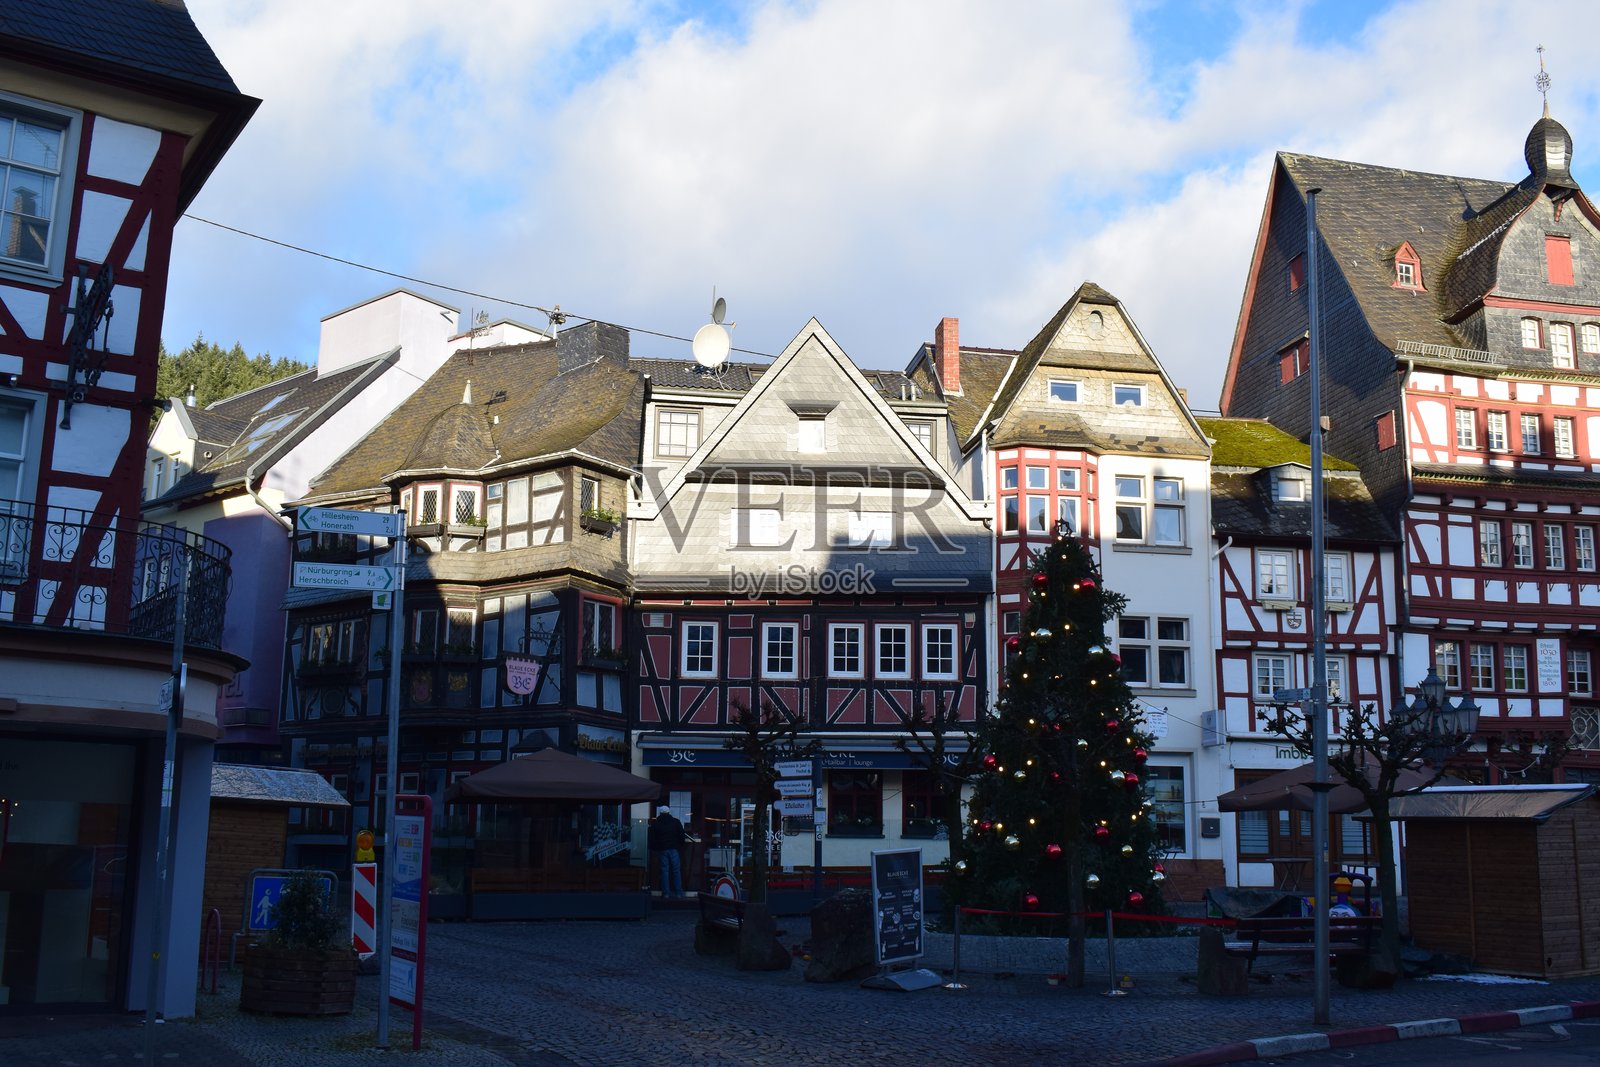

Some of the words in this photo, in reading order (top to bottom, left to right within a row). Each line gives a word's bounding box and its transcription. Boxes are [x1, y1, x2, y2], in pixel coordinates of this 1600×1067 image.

[321, 511, 359, 521] Hillesheim
[382, 516, 390, 524] 29
[320, 521, 354, 530] Honerath
[307, 566, 353, 577] Nürburgring
[299, 576, 349, 585] Herschbroich
[854, 759, 874, 767] lounge
